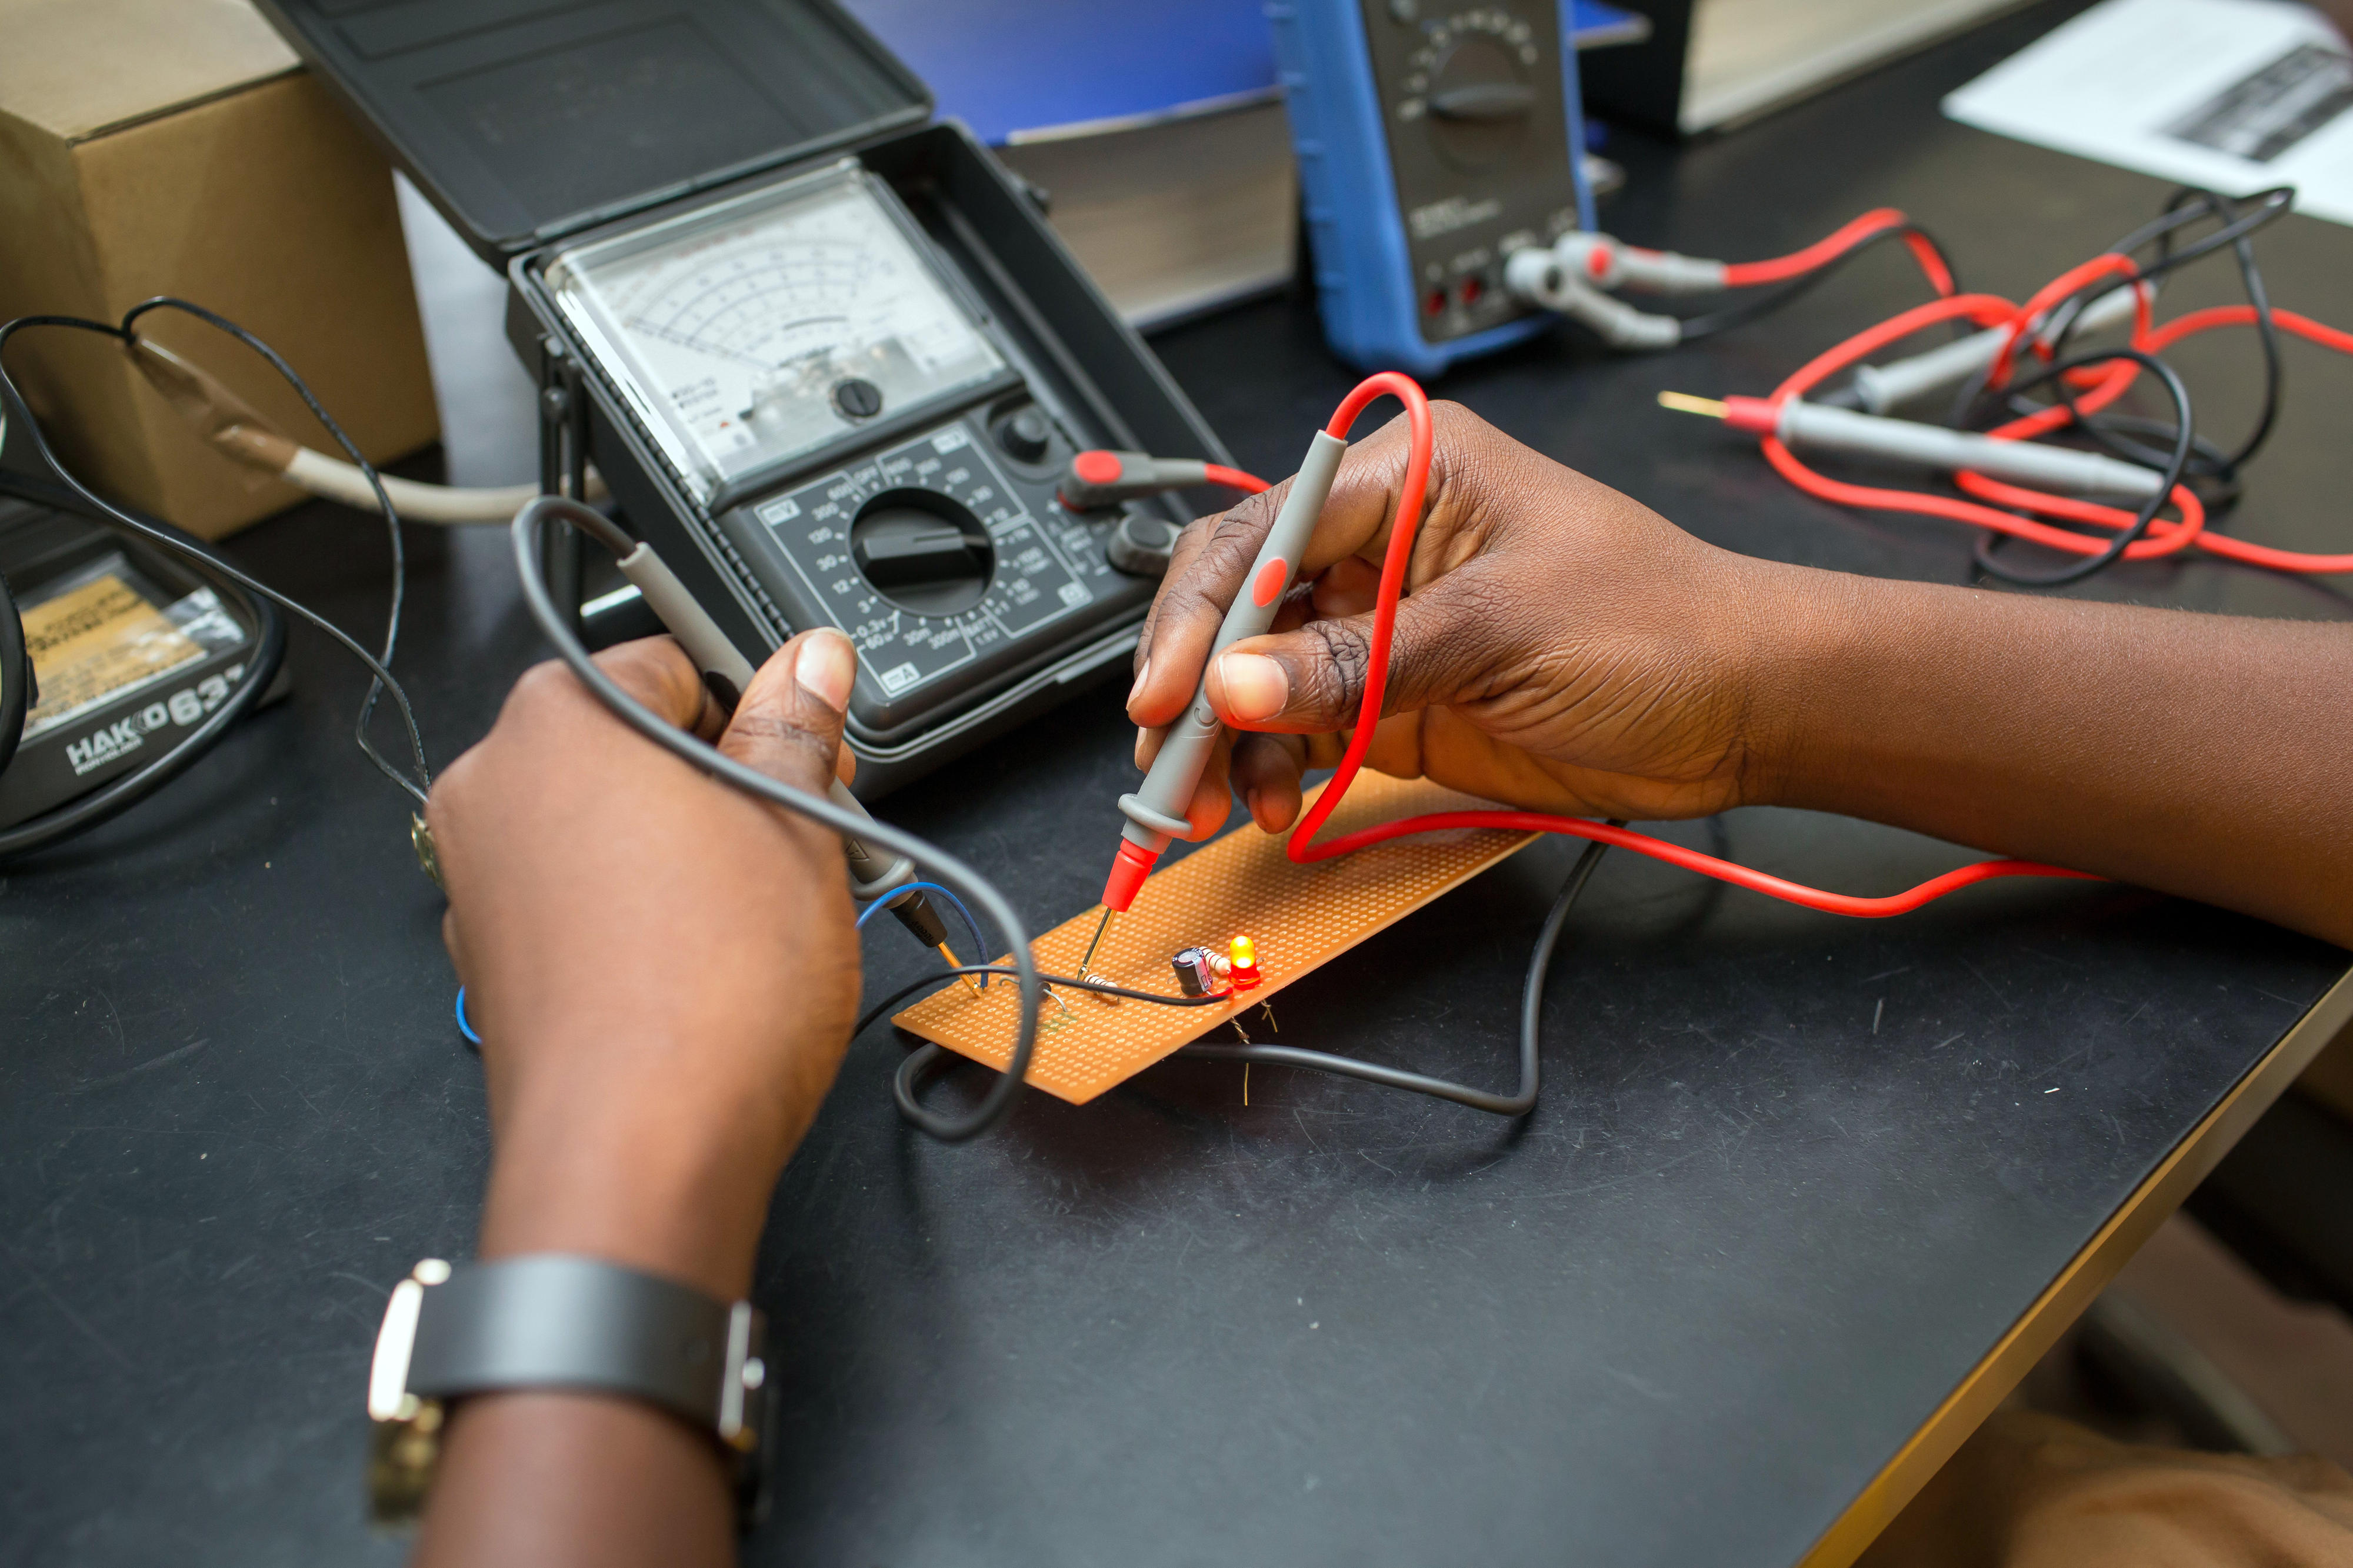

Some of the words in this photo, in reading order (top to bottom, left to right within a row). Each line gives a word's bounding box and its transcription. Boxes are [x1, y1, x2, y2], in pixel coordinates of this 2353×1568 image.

[811, 501, 839, 522] 300
[808, 526, 833, 545] 120
[816, 554, 838, 572] 30
[832, 579, 851, 595] 12
[858, 600, 871, 614] 3
